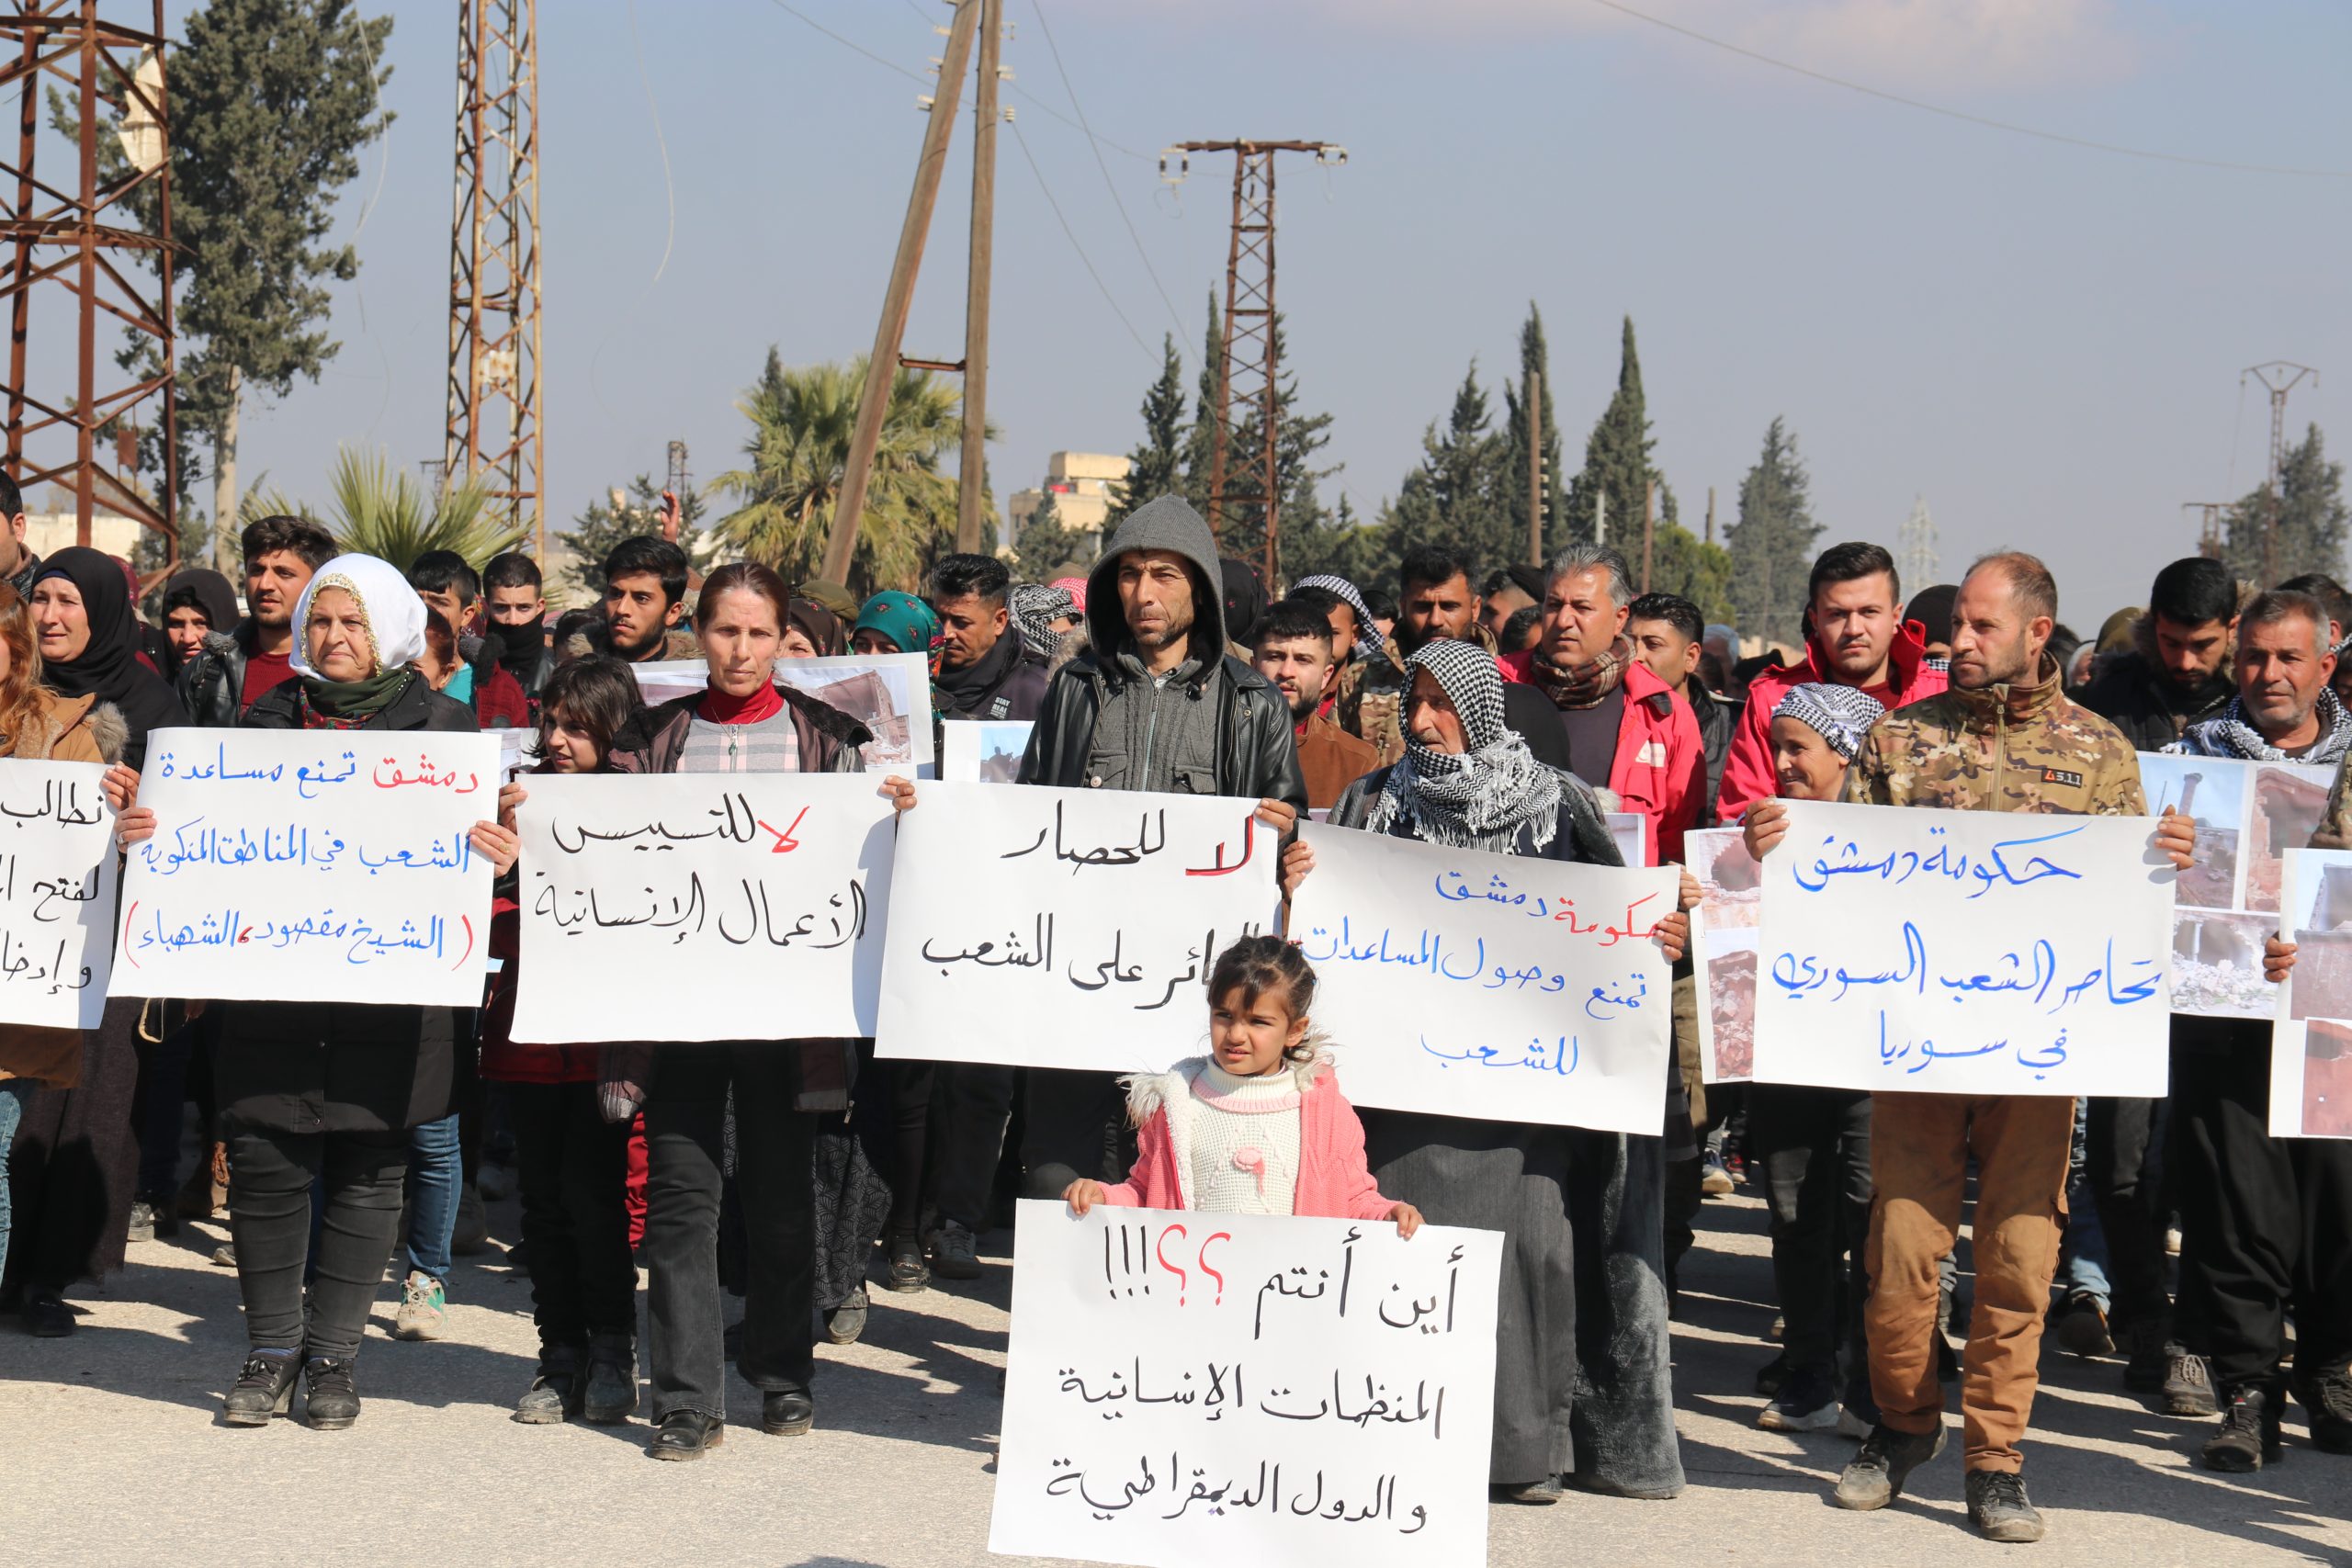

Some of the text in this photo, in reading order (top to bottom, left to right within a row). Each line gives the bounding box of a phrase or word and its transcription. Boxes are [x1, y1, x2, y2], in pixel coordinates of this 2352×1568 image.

[160, 741, 479, 799] دمشق تمنع مساعدة
[2056, 772, 2081, 785] 5.1.1
[0, 779, 104, 829] نطالب
[757, 806, 810, 853] لا
[217, 823, 307, 866] المناطق
[311, 829, 345, 872] في
[358, 827, 473, 875] الشعب
[1000, 798, 1255, 877] لا للحصار
[1792, 820, 2093, 899] حكومة دمشق
[32, 864, 100, 922] لفتح
[535, 870, 868, 949] الأعمال الإنسانية
[1435, 871, 1547, 917] دمشق
[922, 912, 1054, 977] الشعب
[1068, 929, 1144, 991] على
[1302, 915, 1646, 1021] تمنع وصول المساعدات
[1771, 920, 2164, 1014] تحاصر الشعب السوري
[1421, 1035, 1578, 1076] للشعب
[1880, 1010, 2067, 1081] في سوريا
[1253, 1225, 1363, 1341] أنتم
[1378, 1244, 1464, 1336] أين
[1058, 1355, 1445, 1440] المنظمات الإنسانية
